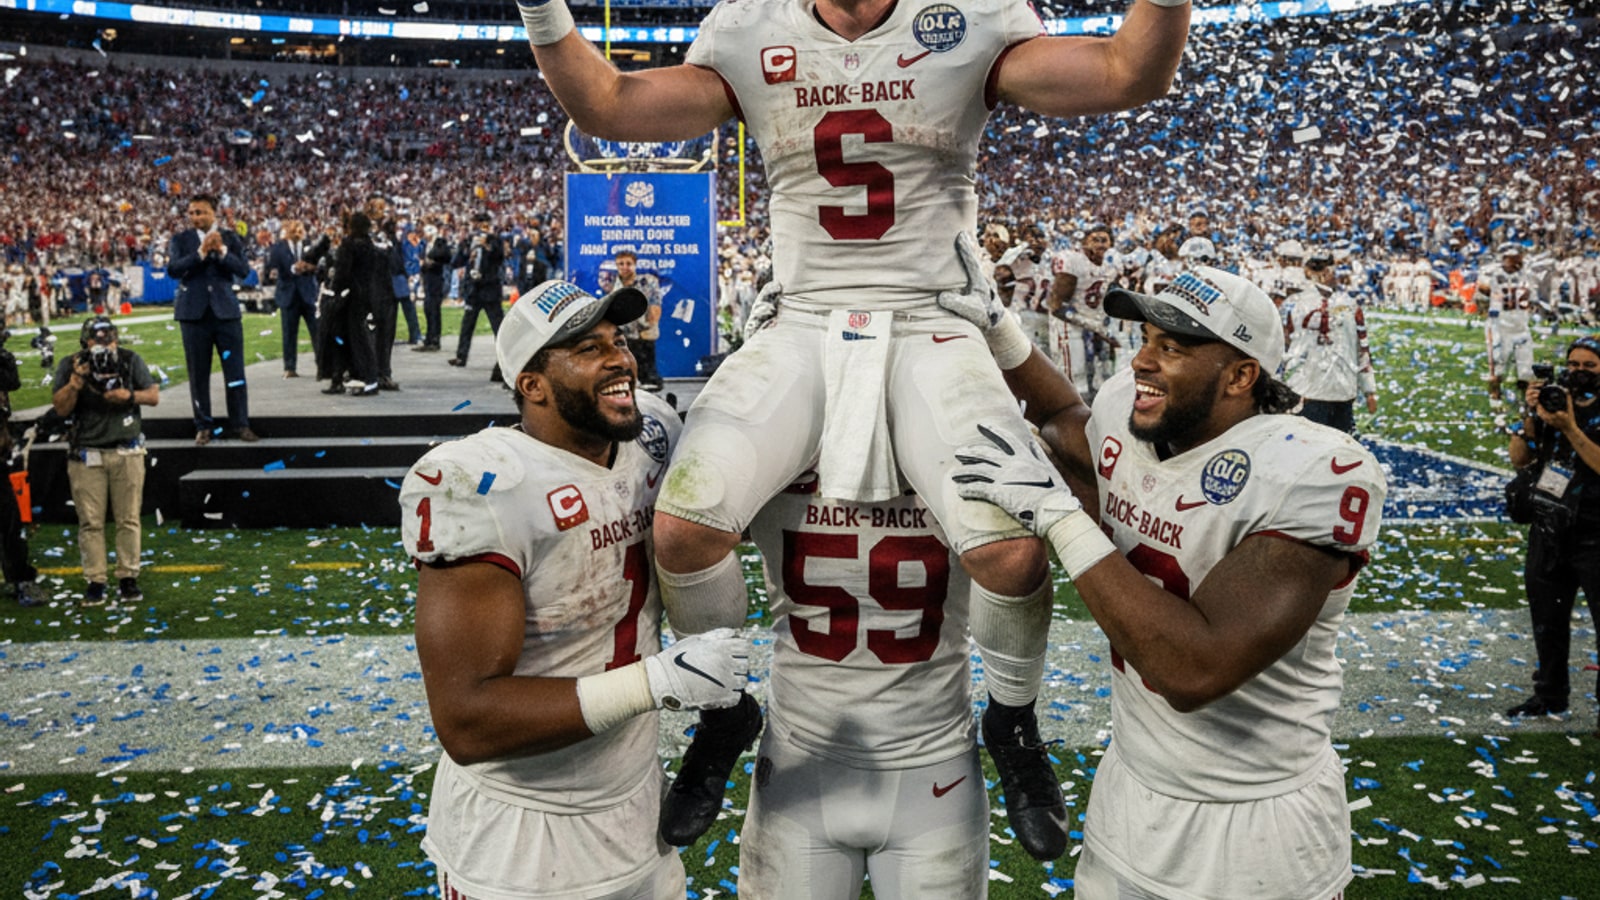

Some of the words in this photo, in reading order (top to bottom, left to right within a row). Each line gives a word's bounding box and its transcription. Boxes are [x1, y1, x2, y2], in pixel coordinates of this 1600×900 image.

[763, 47, 794, 73] C
[416, 497, 435, 553] 1
[549, 488, 583, 520] C
[806, 504, 928, 528] BACK-BACK
[1332, 485, 1370, 545] 9
[605, 540, 651, 672] 1
[782, 529, 951, 664] 59
